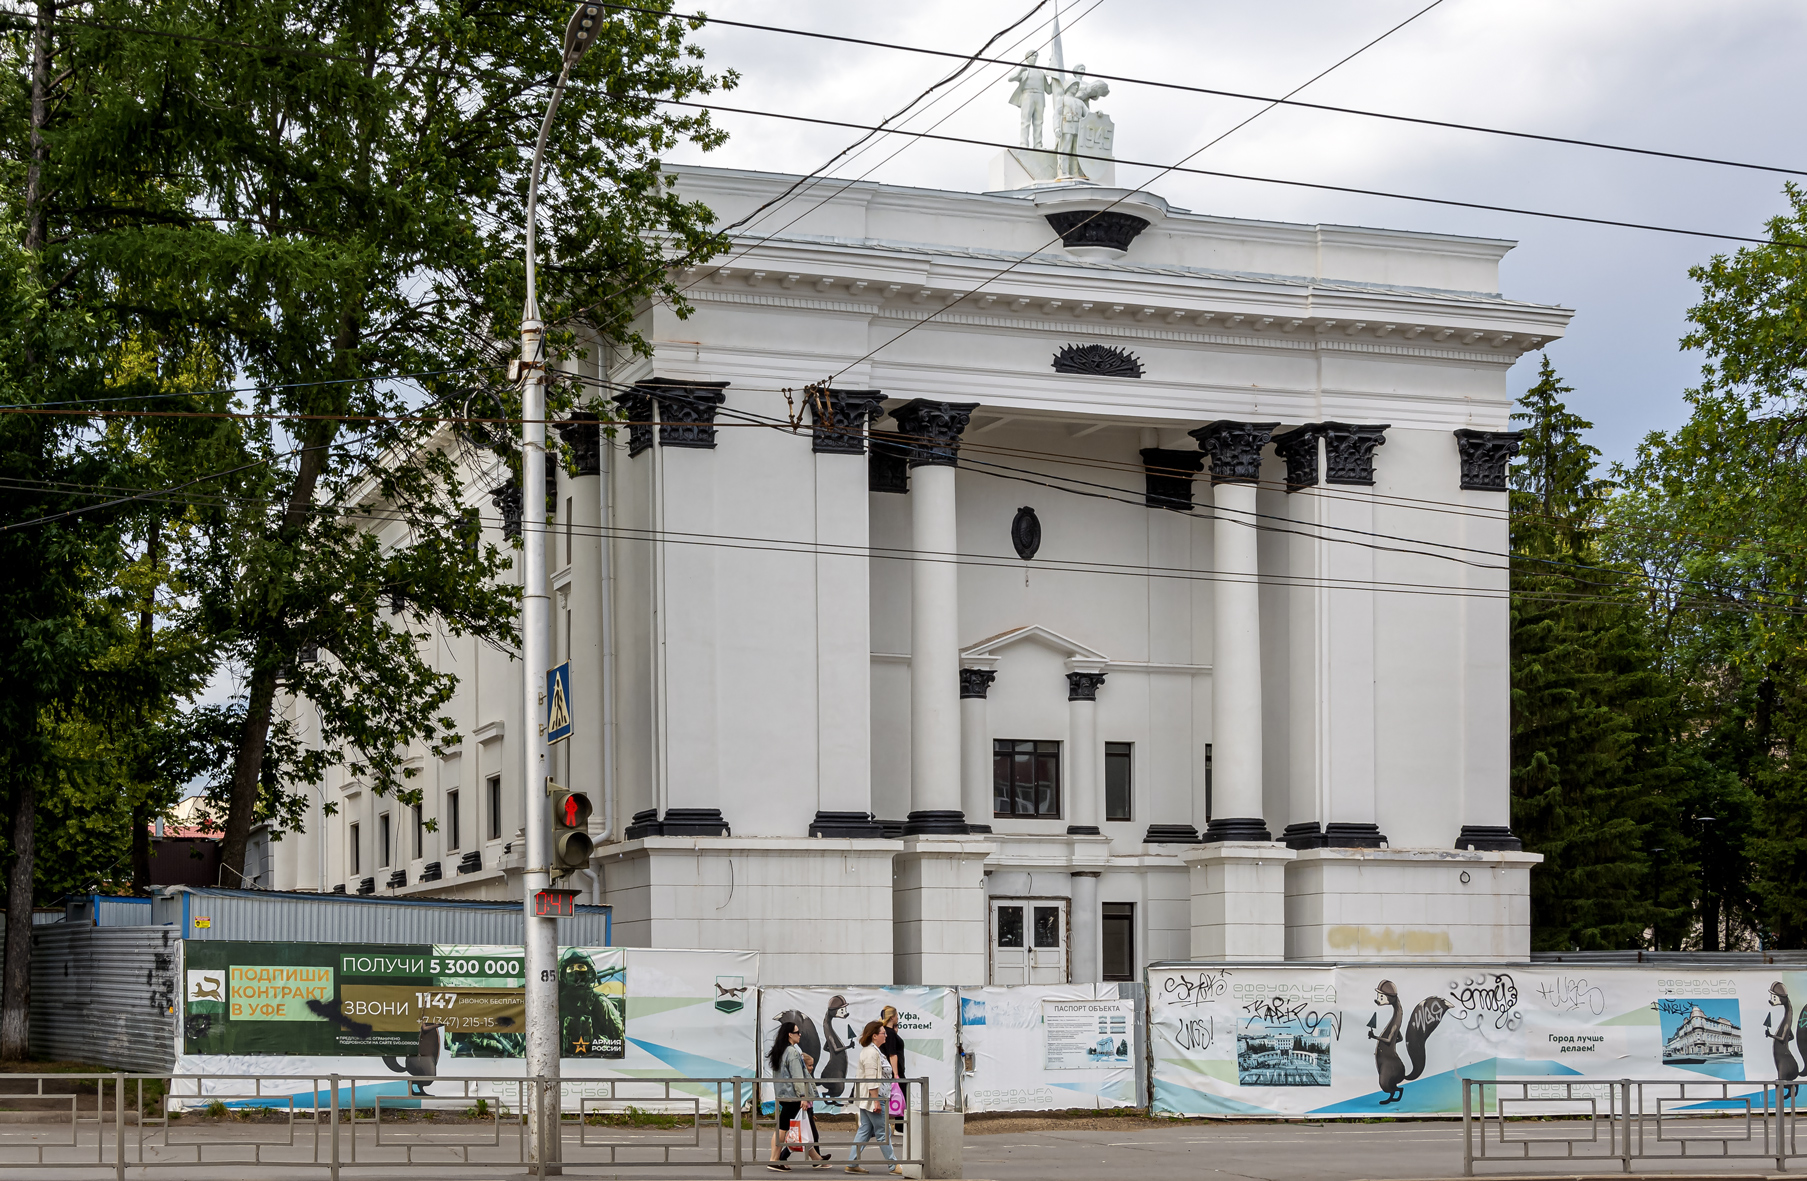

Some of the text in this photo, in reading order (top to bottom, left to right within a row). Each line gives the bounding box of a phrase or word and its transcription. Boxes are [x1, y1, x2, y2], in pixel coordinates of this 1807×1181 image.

[1080, 125, 1112, 150] 1945
[536, 892, 573, 915] 0:41
[343, 957, 520, 975] ПОЛУЧИ 5 300 000
[231, 968, 330, 983] ПОДПИШИ
[540, 970, 556, 983] 85
[231, 986, 327, 1000] КОНТРАКТ
[415, 992, 457, 1009] 1147
[231, 1003, 286, 1017] В УФЕ
[344, 1001, 409, 1016] ЗВОНИ
[462, 1016, 500, 1028] 215-15-
[898, 1011, 920, 1021] Уфа,
[897, 1022, 932, 1030] ботаем!
[1548, 1033, 1604, 1043] Город лучше
[1560, 1043, 1595, 1053] делаем!
